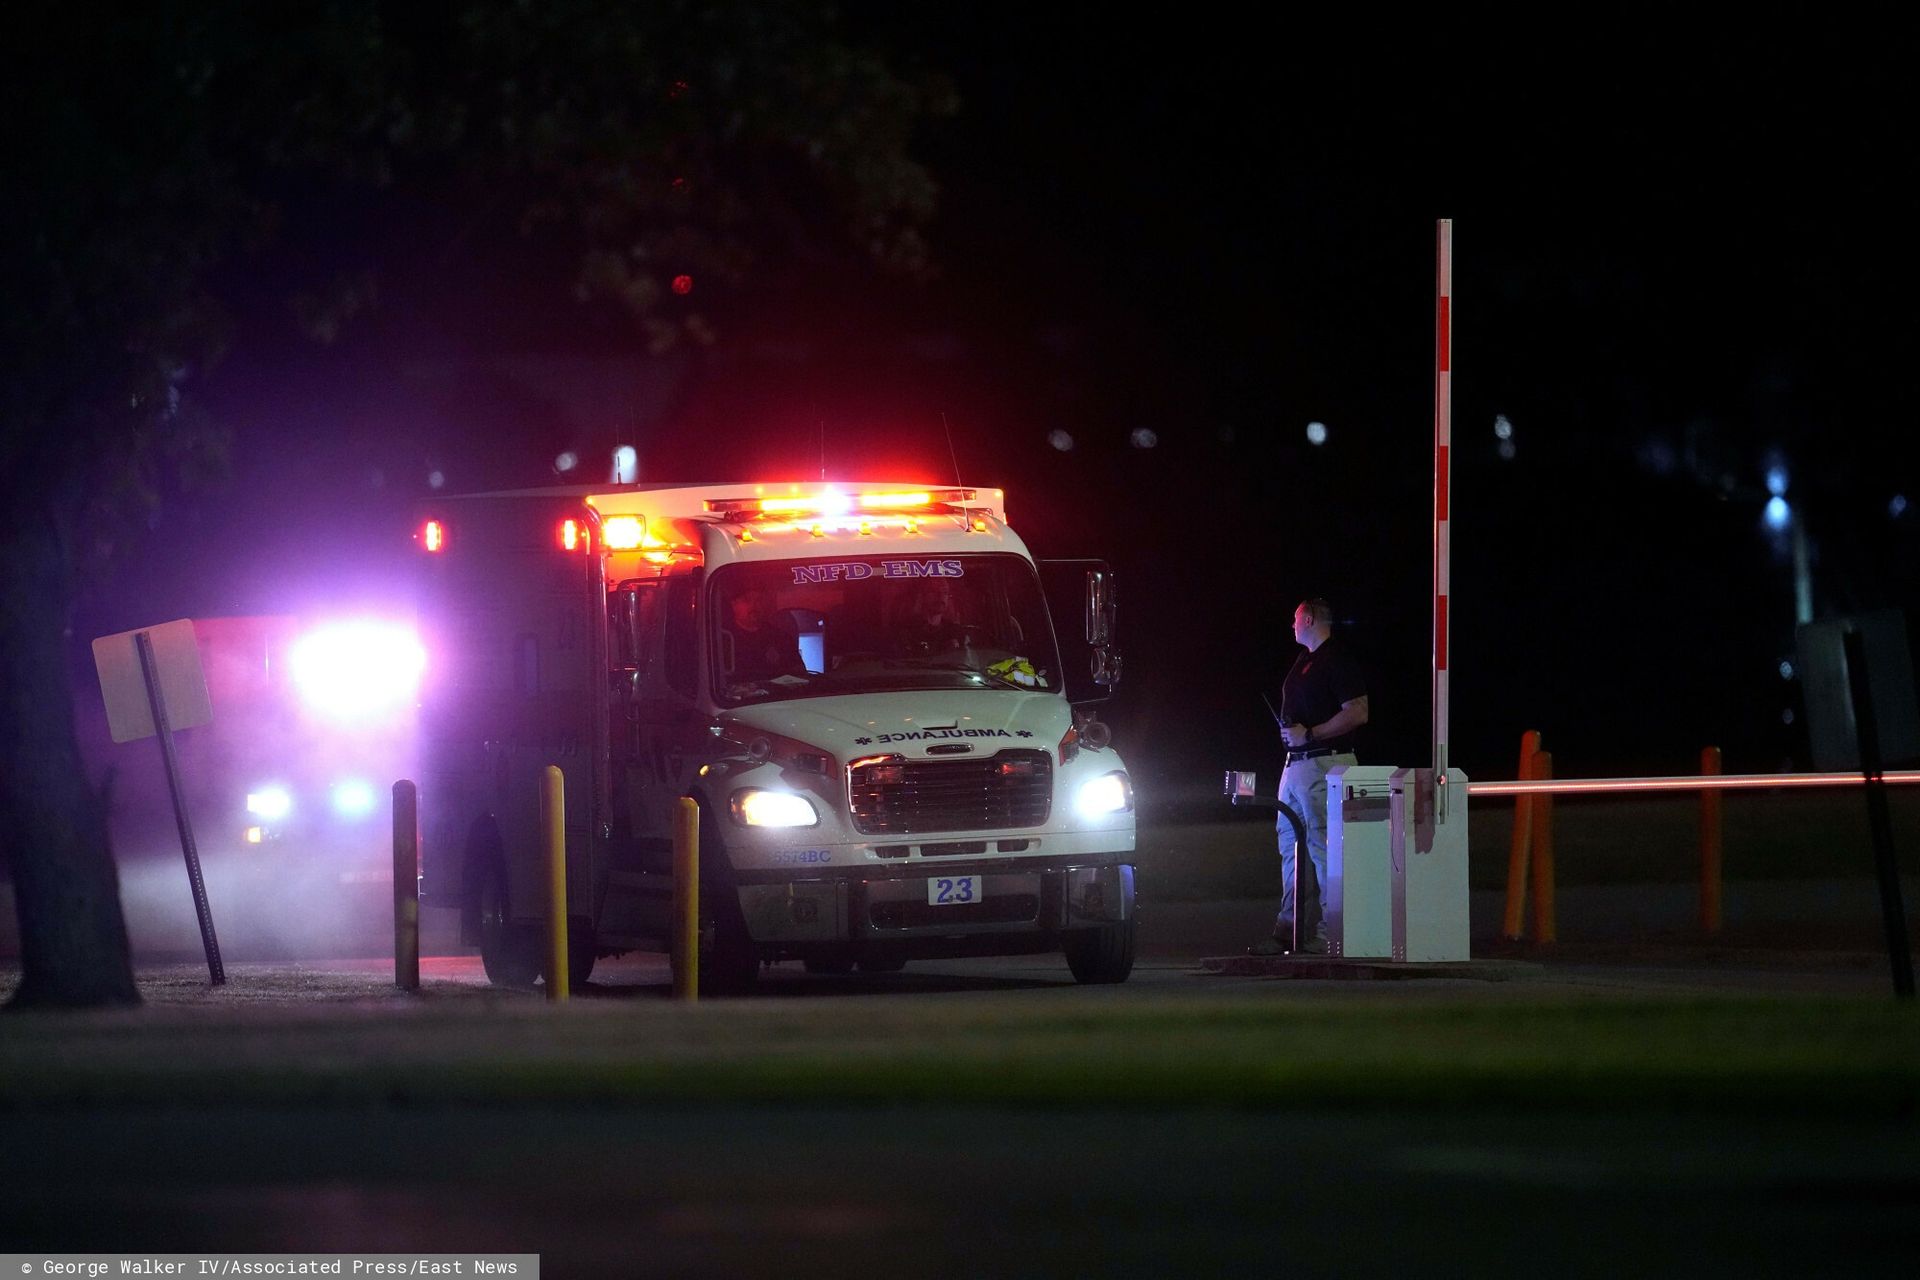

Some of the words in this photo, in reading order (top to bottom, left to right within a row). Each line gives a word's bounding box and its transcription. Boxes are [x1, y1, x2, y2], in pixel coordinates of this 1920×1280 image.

[792, 562, 873, 584] NFD
[881, 560, 964, 579] EMS
[937, 878, 973, 903] 23
